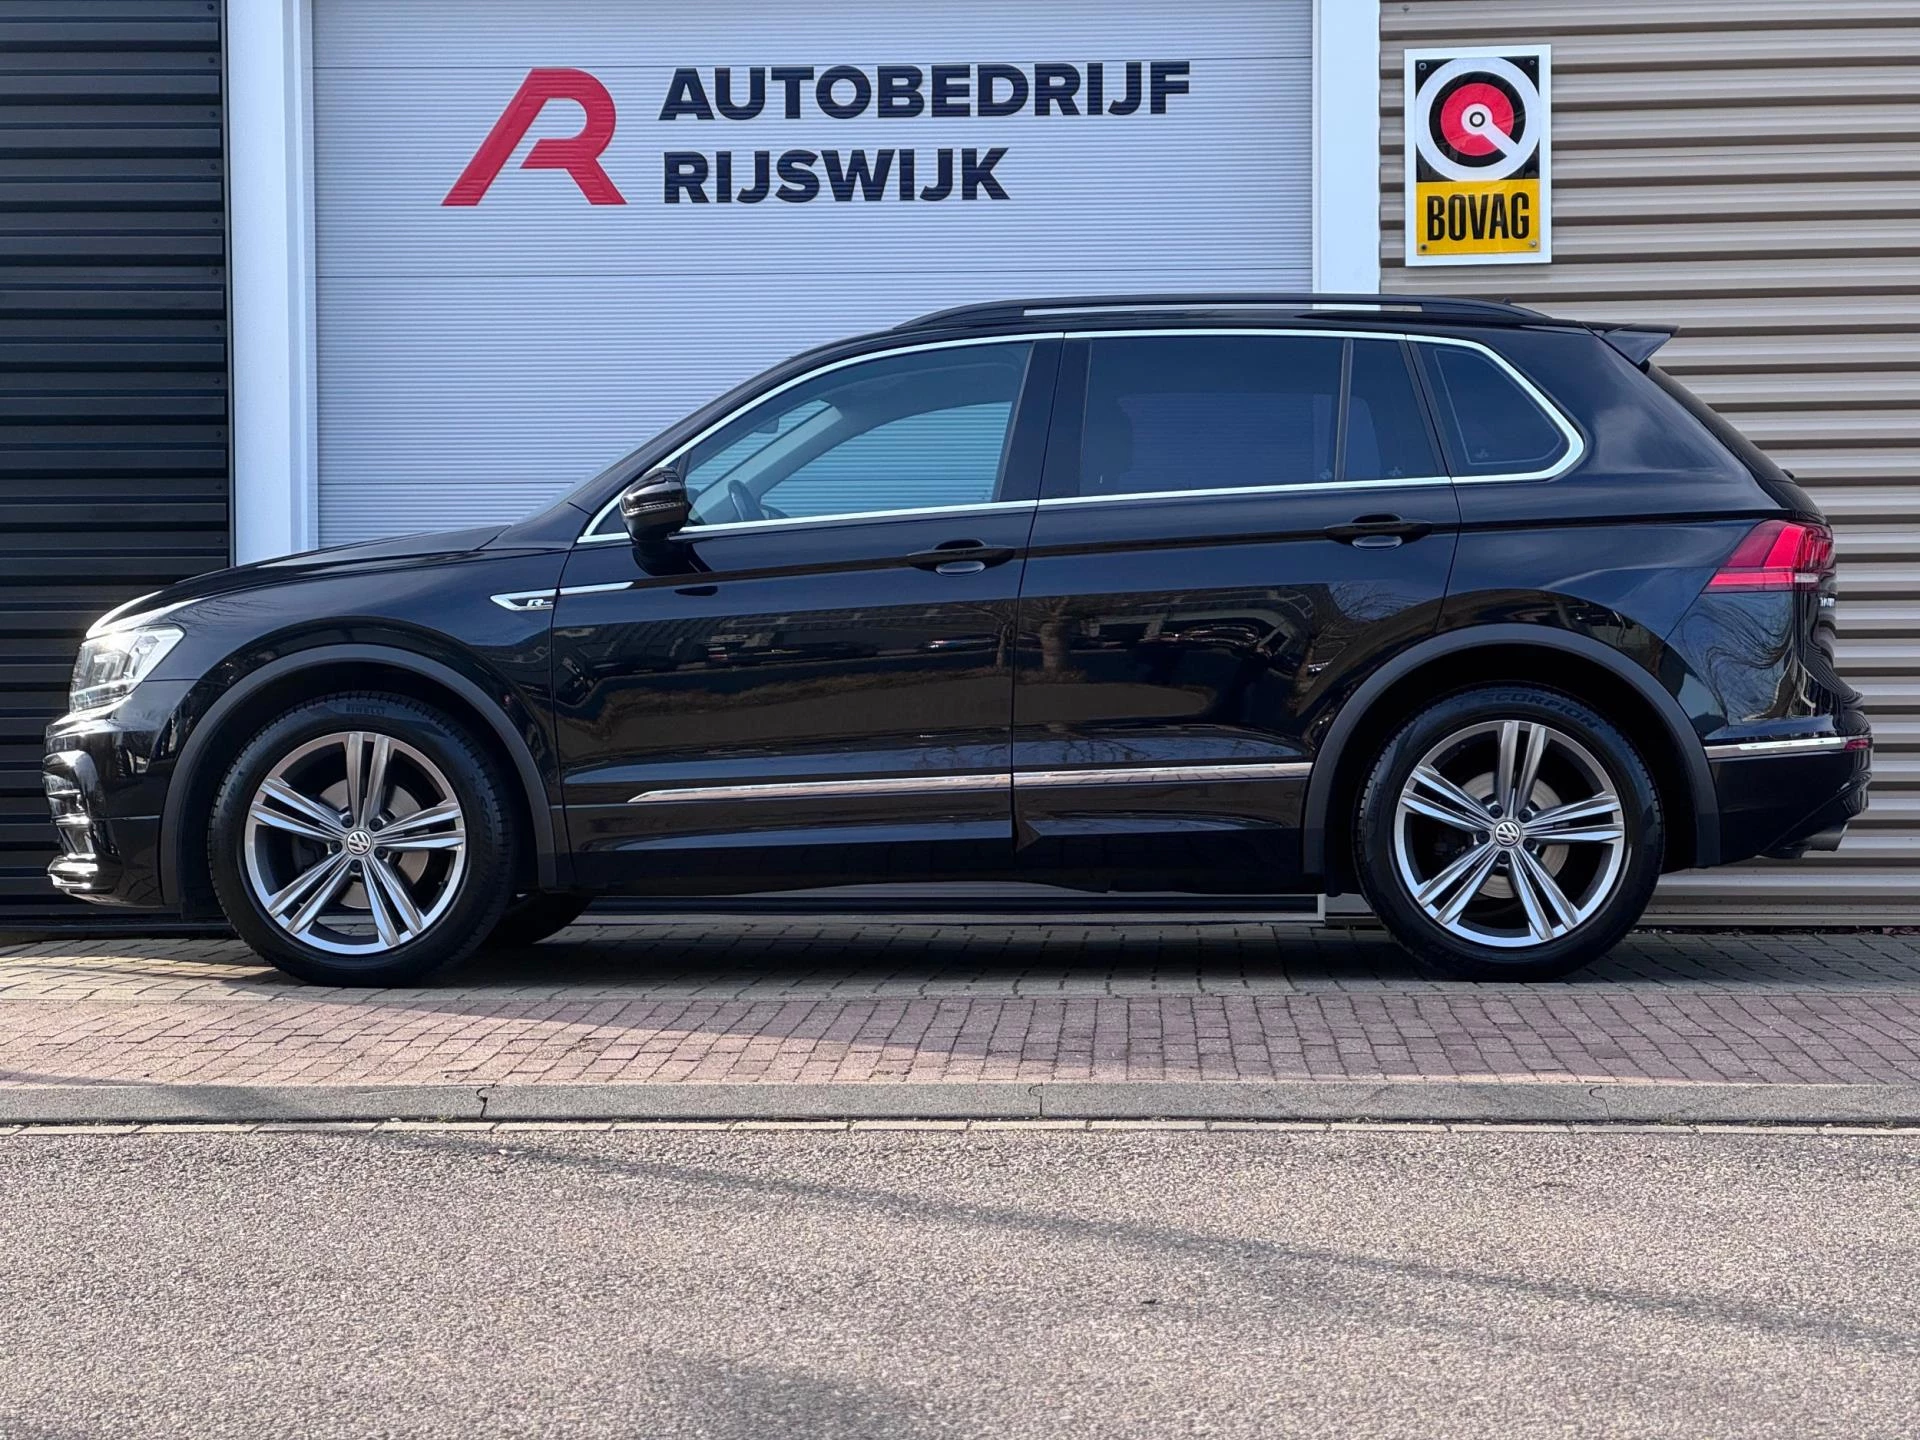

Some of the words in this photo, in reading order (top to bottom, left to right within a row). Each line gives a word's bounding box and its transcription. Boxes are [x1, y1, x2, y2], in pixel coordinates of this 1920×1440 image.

[658, 61, 1190, 121] AUTOBEDRIJF
[663, 148, 1010, 204] RIJSWIJK
[1427, 192, 1530, 241] BOVAG
